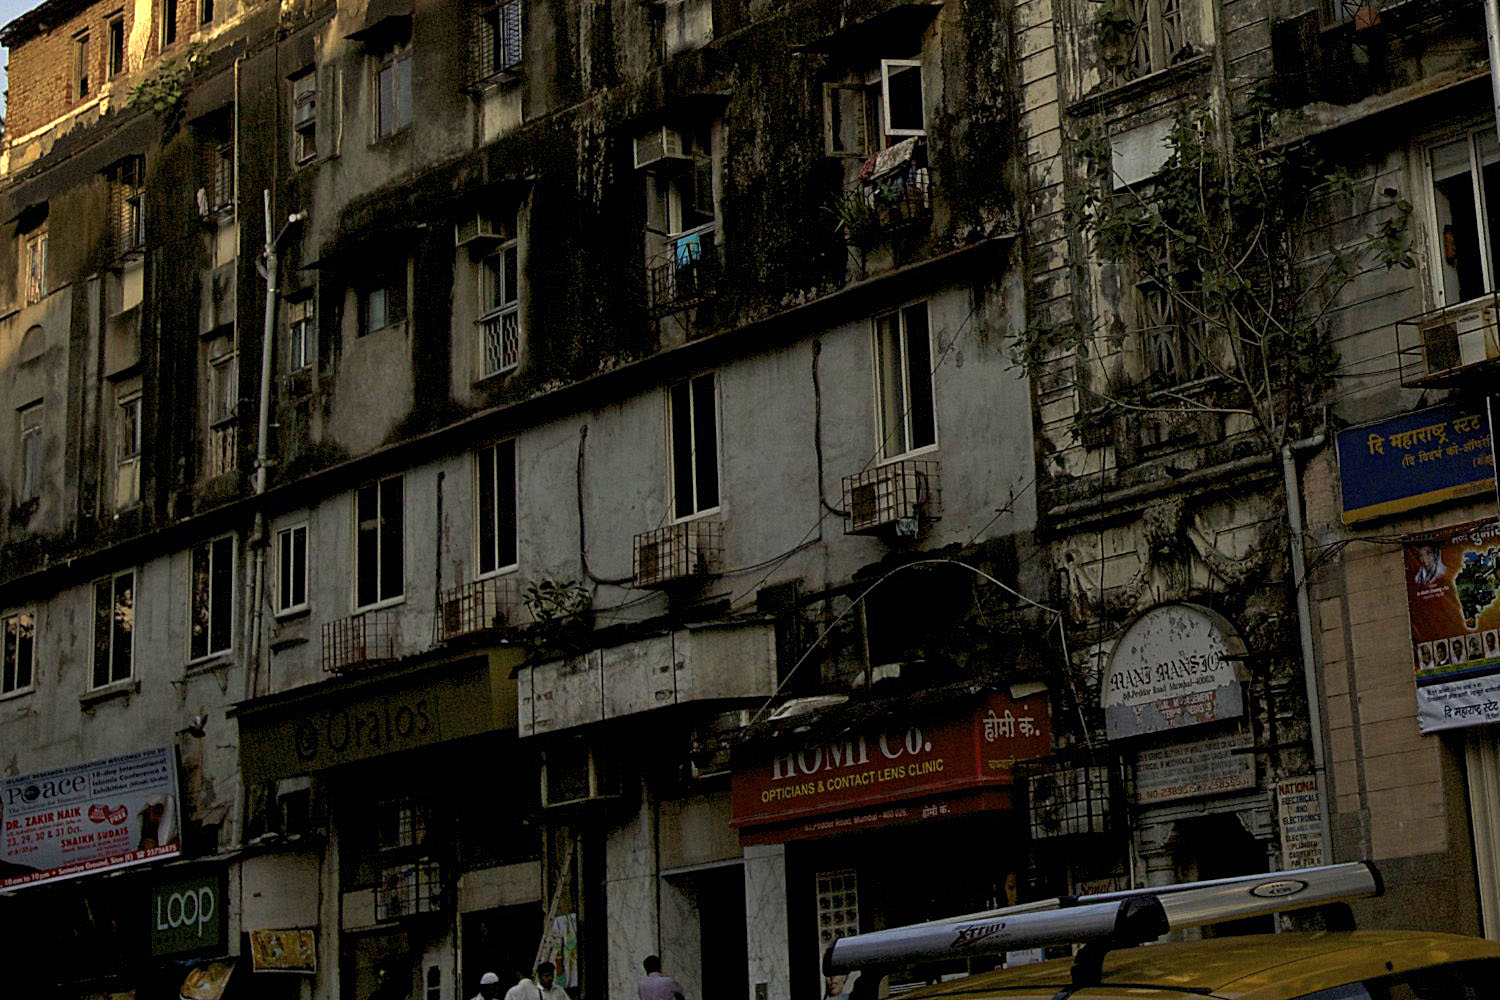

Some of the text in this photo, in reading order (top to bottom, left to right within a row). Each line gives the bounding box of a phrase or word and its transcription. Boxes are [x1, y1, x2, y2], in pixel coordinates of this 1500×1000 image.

[1368, 433, 1385, 456] दि
[1389, 422, 1448, 450] महाराष्ट्र
[983, 709, 1015, 742] होमी
[761, 758, 945, 804] OPTICIANS & CONTACT LENS CLINIC
[6, 820, 22, 831] DR.
[26, 812, 54, 827] ZAKIR
[57, 807, 81, 820] NAIK
[61, 833, 94, 848] SHAIKH
